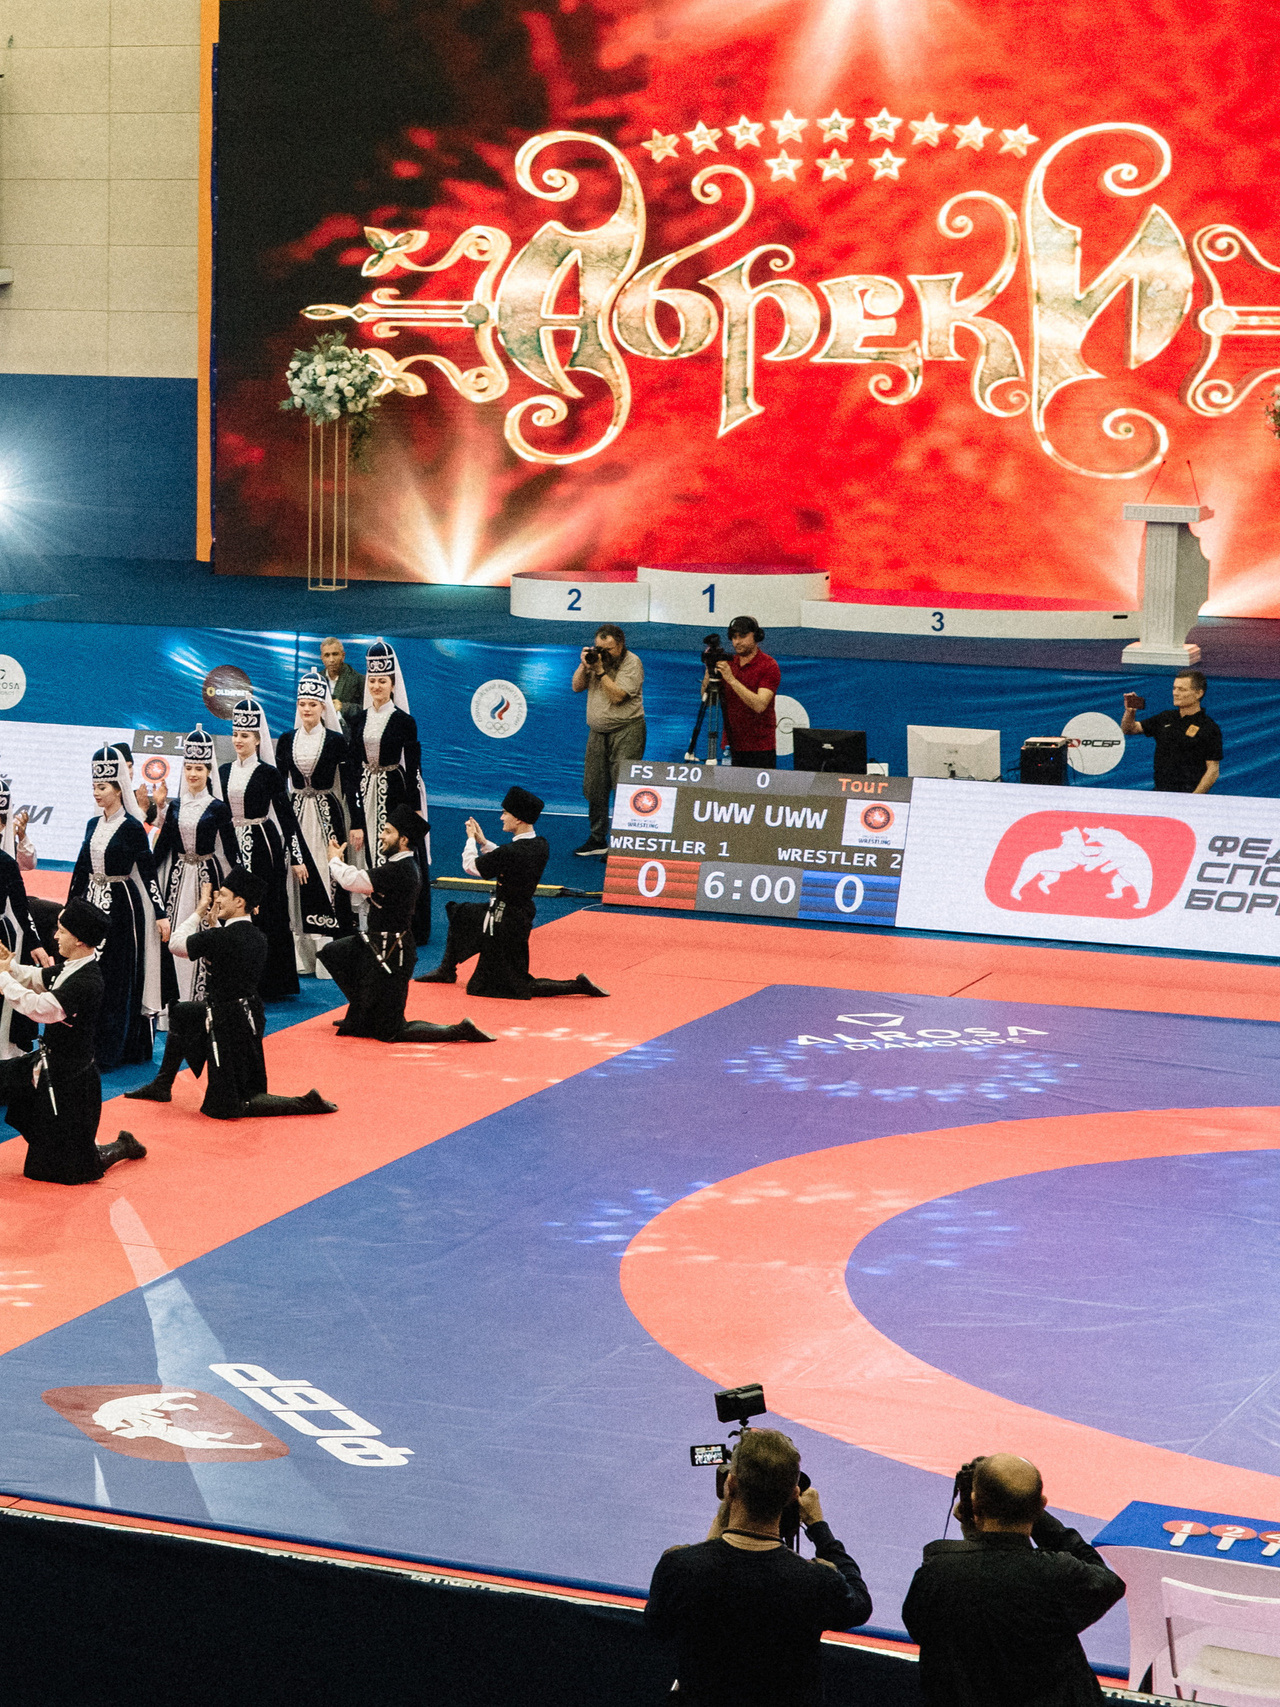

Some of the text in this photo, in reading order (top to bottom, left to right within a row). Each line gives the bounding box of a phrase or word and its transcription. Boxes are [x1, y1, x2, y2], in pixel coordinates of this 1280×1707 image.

[567, 588, 582, 611] 2
[701, 584, 716, 613] 1
[931, 611, 945, 631] 3
[143, 734, 164, 748] FS
[1081, 739, 1121, 748] ФСБР
[630, 764, 702, 783] FS 120
[756, 771, 770, 788] 0
[838, 777, 889, 794] Tour
[693, 800, 828, 830] UWW UWW
[610, 835, 730, 857] WRESTLER 1
[777, 847, 902, 869] WRESTLER 2
[637, 860, 667, 898] 0
[704, 870, 796, 904] 6:00
[834, 875, 865, 913] 0
[1184, 888, 1280, 916] БОР
[797, 1026, 1050, 1046] ALROSA
[843, 1037, 1028, 1051] DIAMONDS
[1179, 1523, 1195, 1534] 1
[1222, 1526, 1246, 1538] 2
